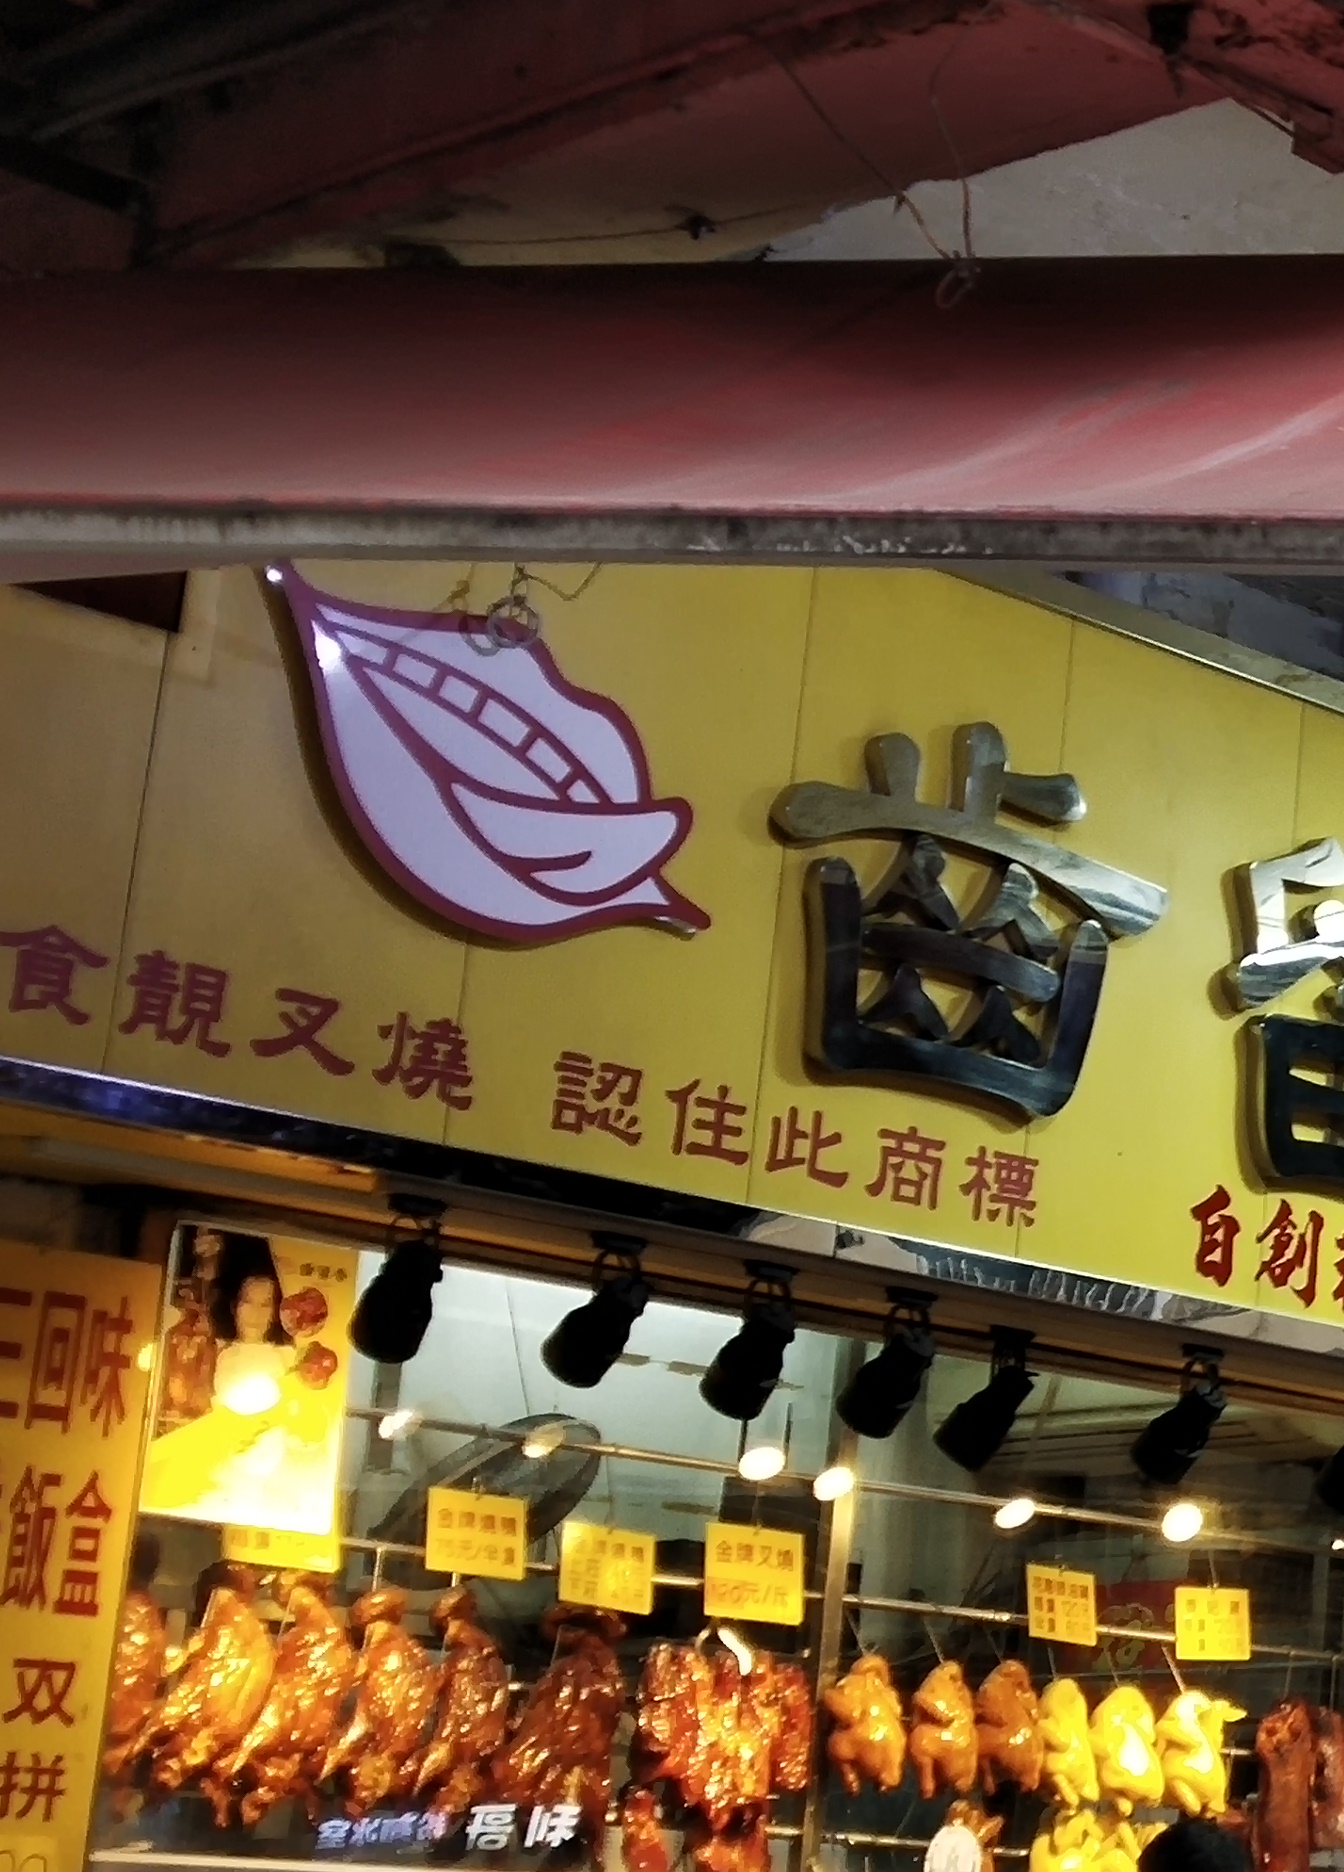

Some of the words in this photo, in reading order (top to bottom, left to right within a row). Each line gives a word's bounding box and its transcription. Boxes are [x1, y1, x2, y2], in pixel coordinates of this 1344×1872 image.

[551, 1051, 1040, 1229] 認住此商標
